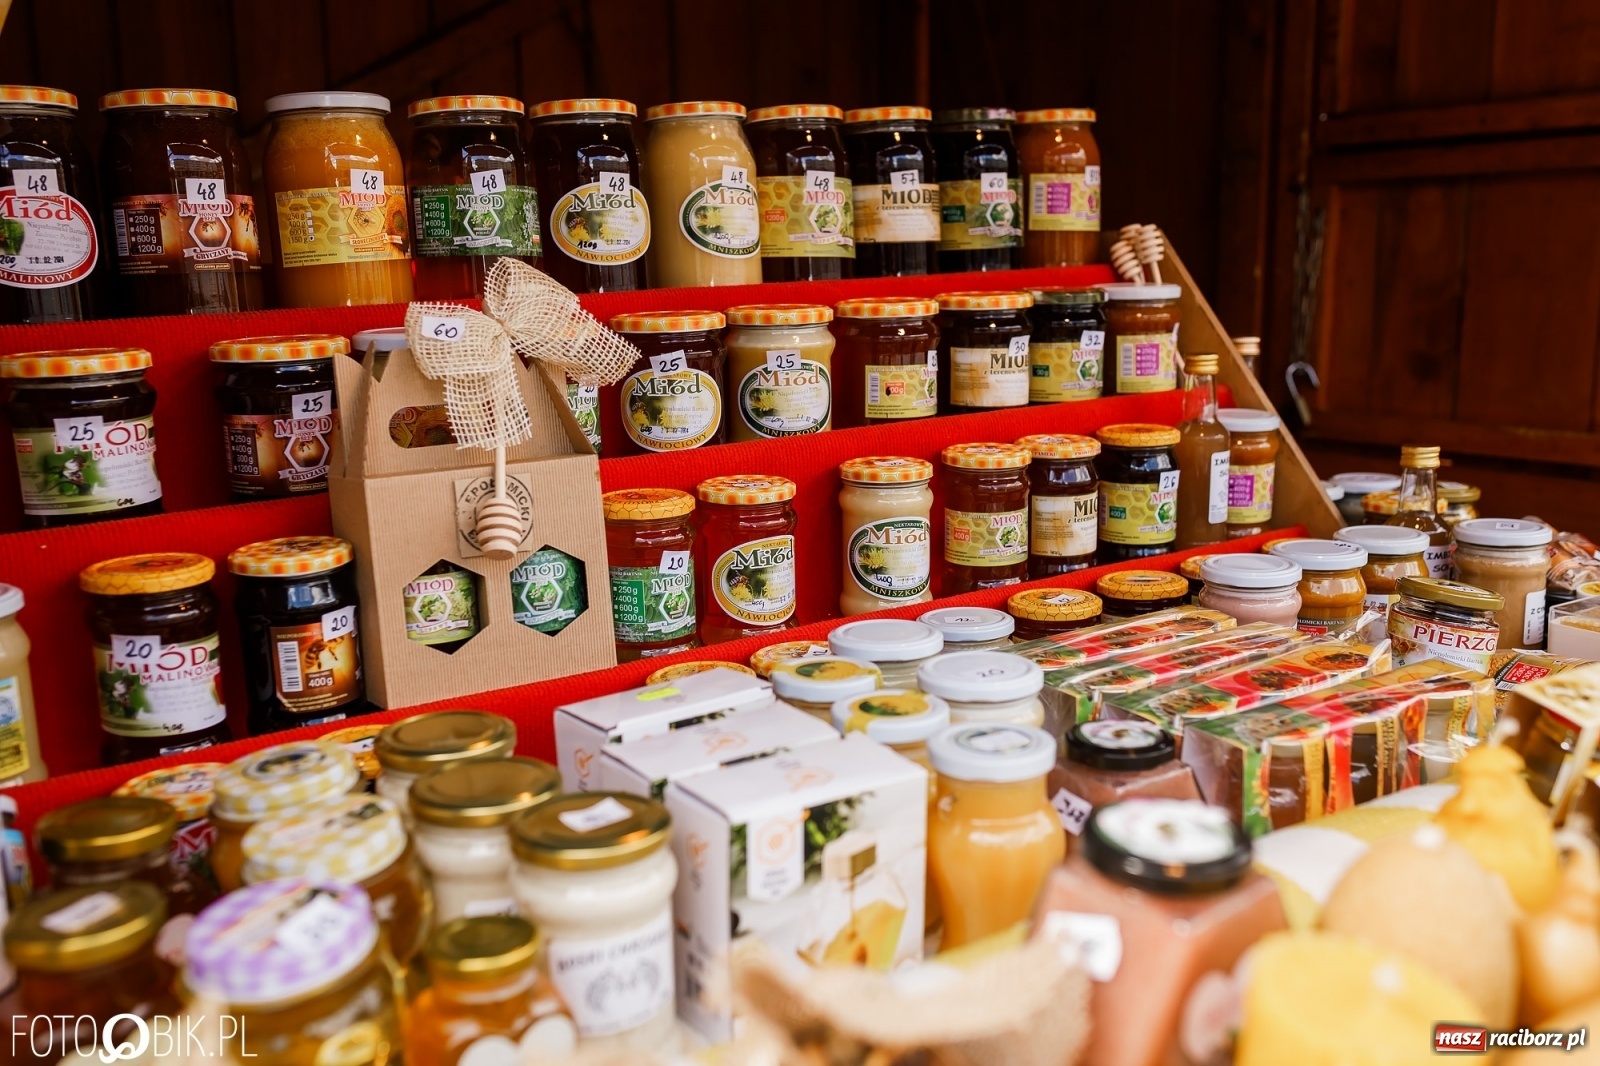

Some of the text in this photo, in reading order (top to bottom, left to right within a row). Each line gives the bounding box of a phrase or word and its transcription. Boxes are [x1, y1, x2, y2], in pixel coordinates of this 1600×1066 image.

[27, 174, 48, 194] 48
[362, 172, 378, 190] 48
[482, 174, 498, 192] 48
[609, 176, 624, 192] 48
[730, 172, 743, 184] 48
[814, 176, 830, 192] 48
[900, 172, 916, 185] 57
[988, 176, 1004, 188] 60
[197, 182, 217, 201] 48
[570, 188, 636, 210] Miód
[702, 188, 755, 206] Miód
[134, 215, 148, 223] 250
[136, 224, 148, 233] 400
[430, 228, 445, 236] 1200
[136, 234, 150, 243] 600
[138, 244, 155, 253] 1200
[195, 248, 231, 261] GRYCZANY
[434, 323, 458, 338] 60
[1014, 342, 1026, 354] 30
[1085, 335, 1100, 346] 32
[659, 356, 682, 372] 25
[776, 354, 796, 369] 25
[756, 365, 820, 387] Miód
[632, 373, 703, 395] Miód
[302, 395, 324, 413] 25
[69, 422, 94, 442] 25
[636, 432, 707, 450] NAWŁOCIOWY
[238, 464, 252, 472] 1200
[291, 466, 327, 480] GRYCZANY
[865, 521, 928, 545] Miód
[954, 532, 964, 540] 400
[732, 538, 794, 568] Miód
[668, 556, 684, 570] 20
[618, 586, 632, 594] 250
[870, 582, 927, 597] MNISZKOWY
[618, 595, 632, 603] 400
[332, 616, 348, 632] 20
[620, 613, 637, 621] 1200
[125, 640, 152, 658] 20
[308, 677, 334, 687] 400 g
